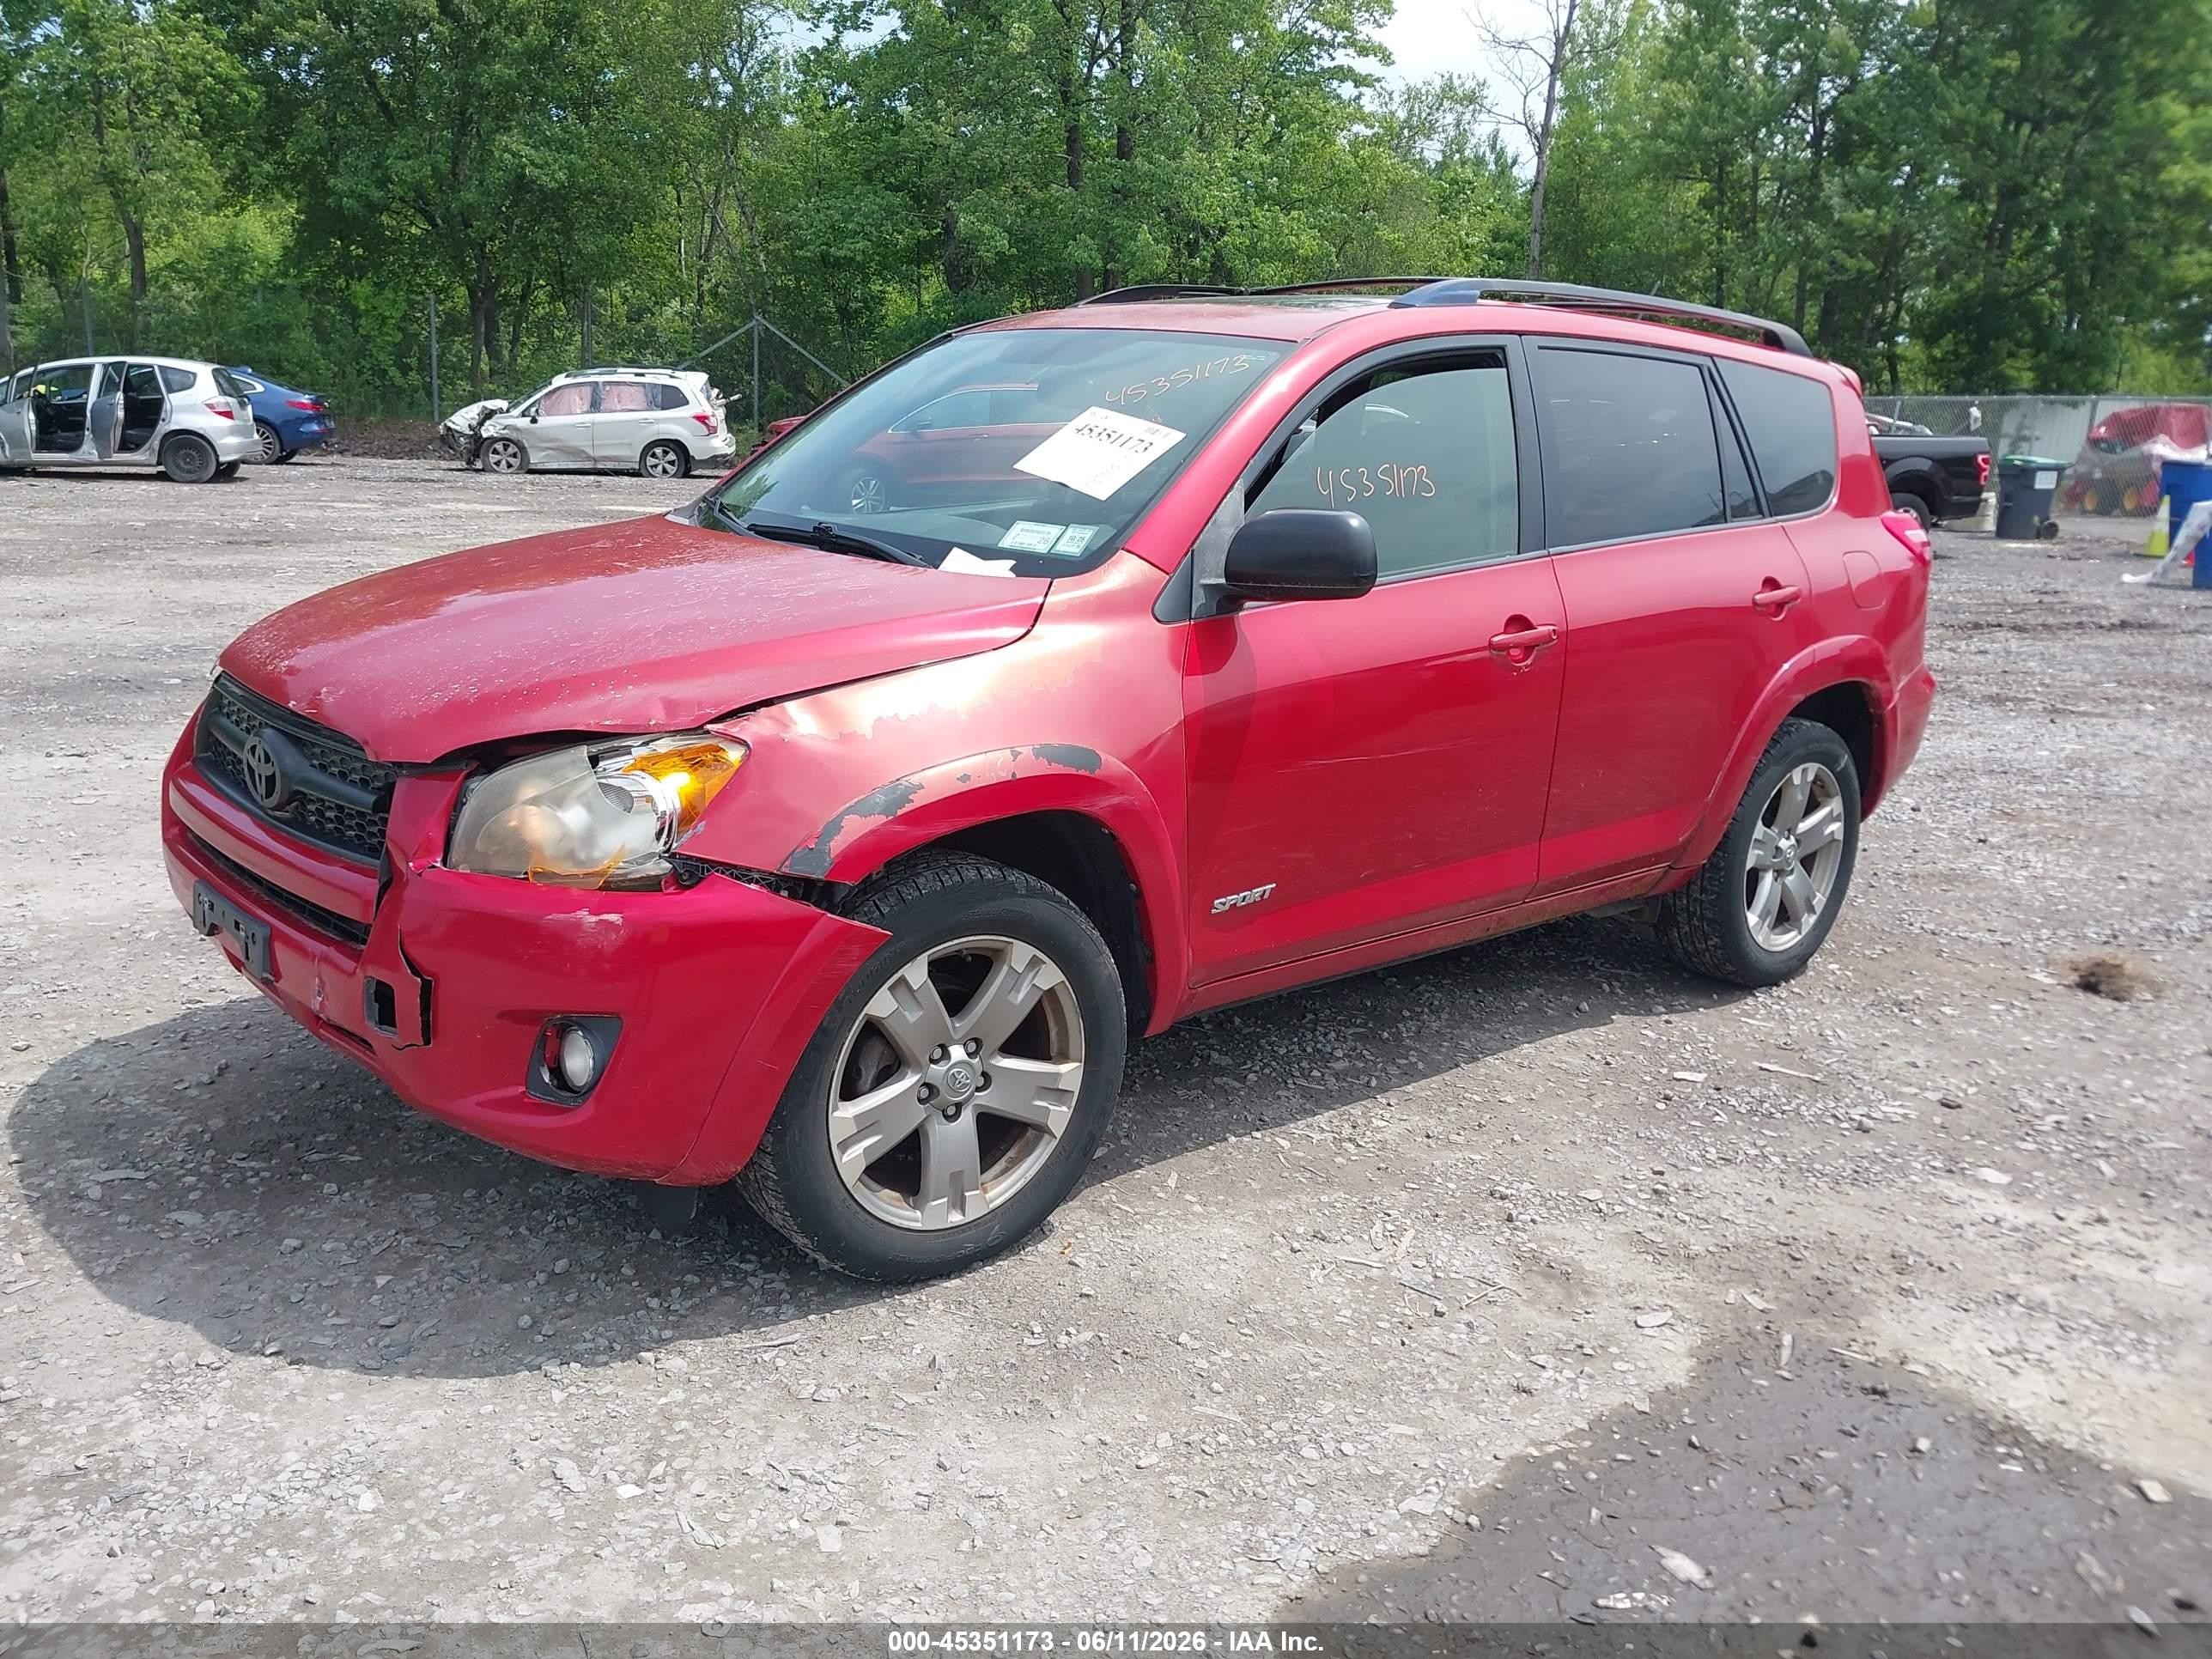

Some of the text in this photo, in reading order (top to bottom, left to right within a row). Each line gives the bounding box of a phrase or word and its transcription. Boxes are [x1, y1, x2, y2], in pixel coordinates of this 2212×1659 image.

[1105, 355, 1249, 405] 45351173
[1075, 423, 1154, 453] 45351173
[1316, 464, 1435, 508] 45351173
[1211, 883, 1277, 915] SPORT
